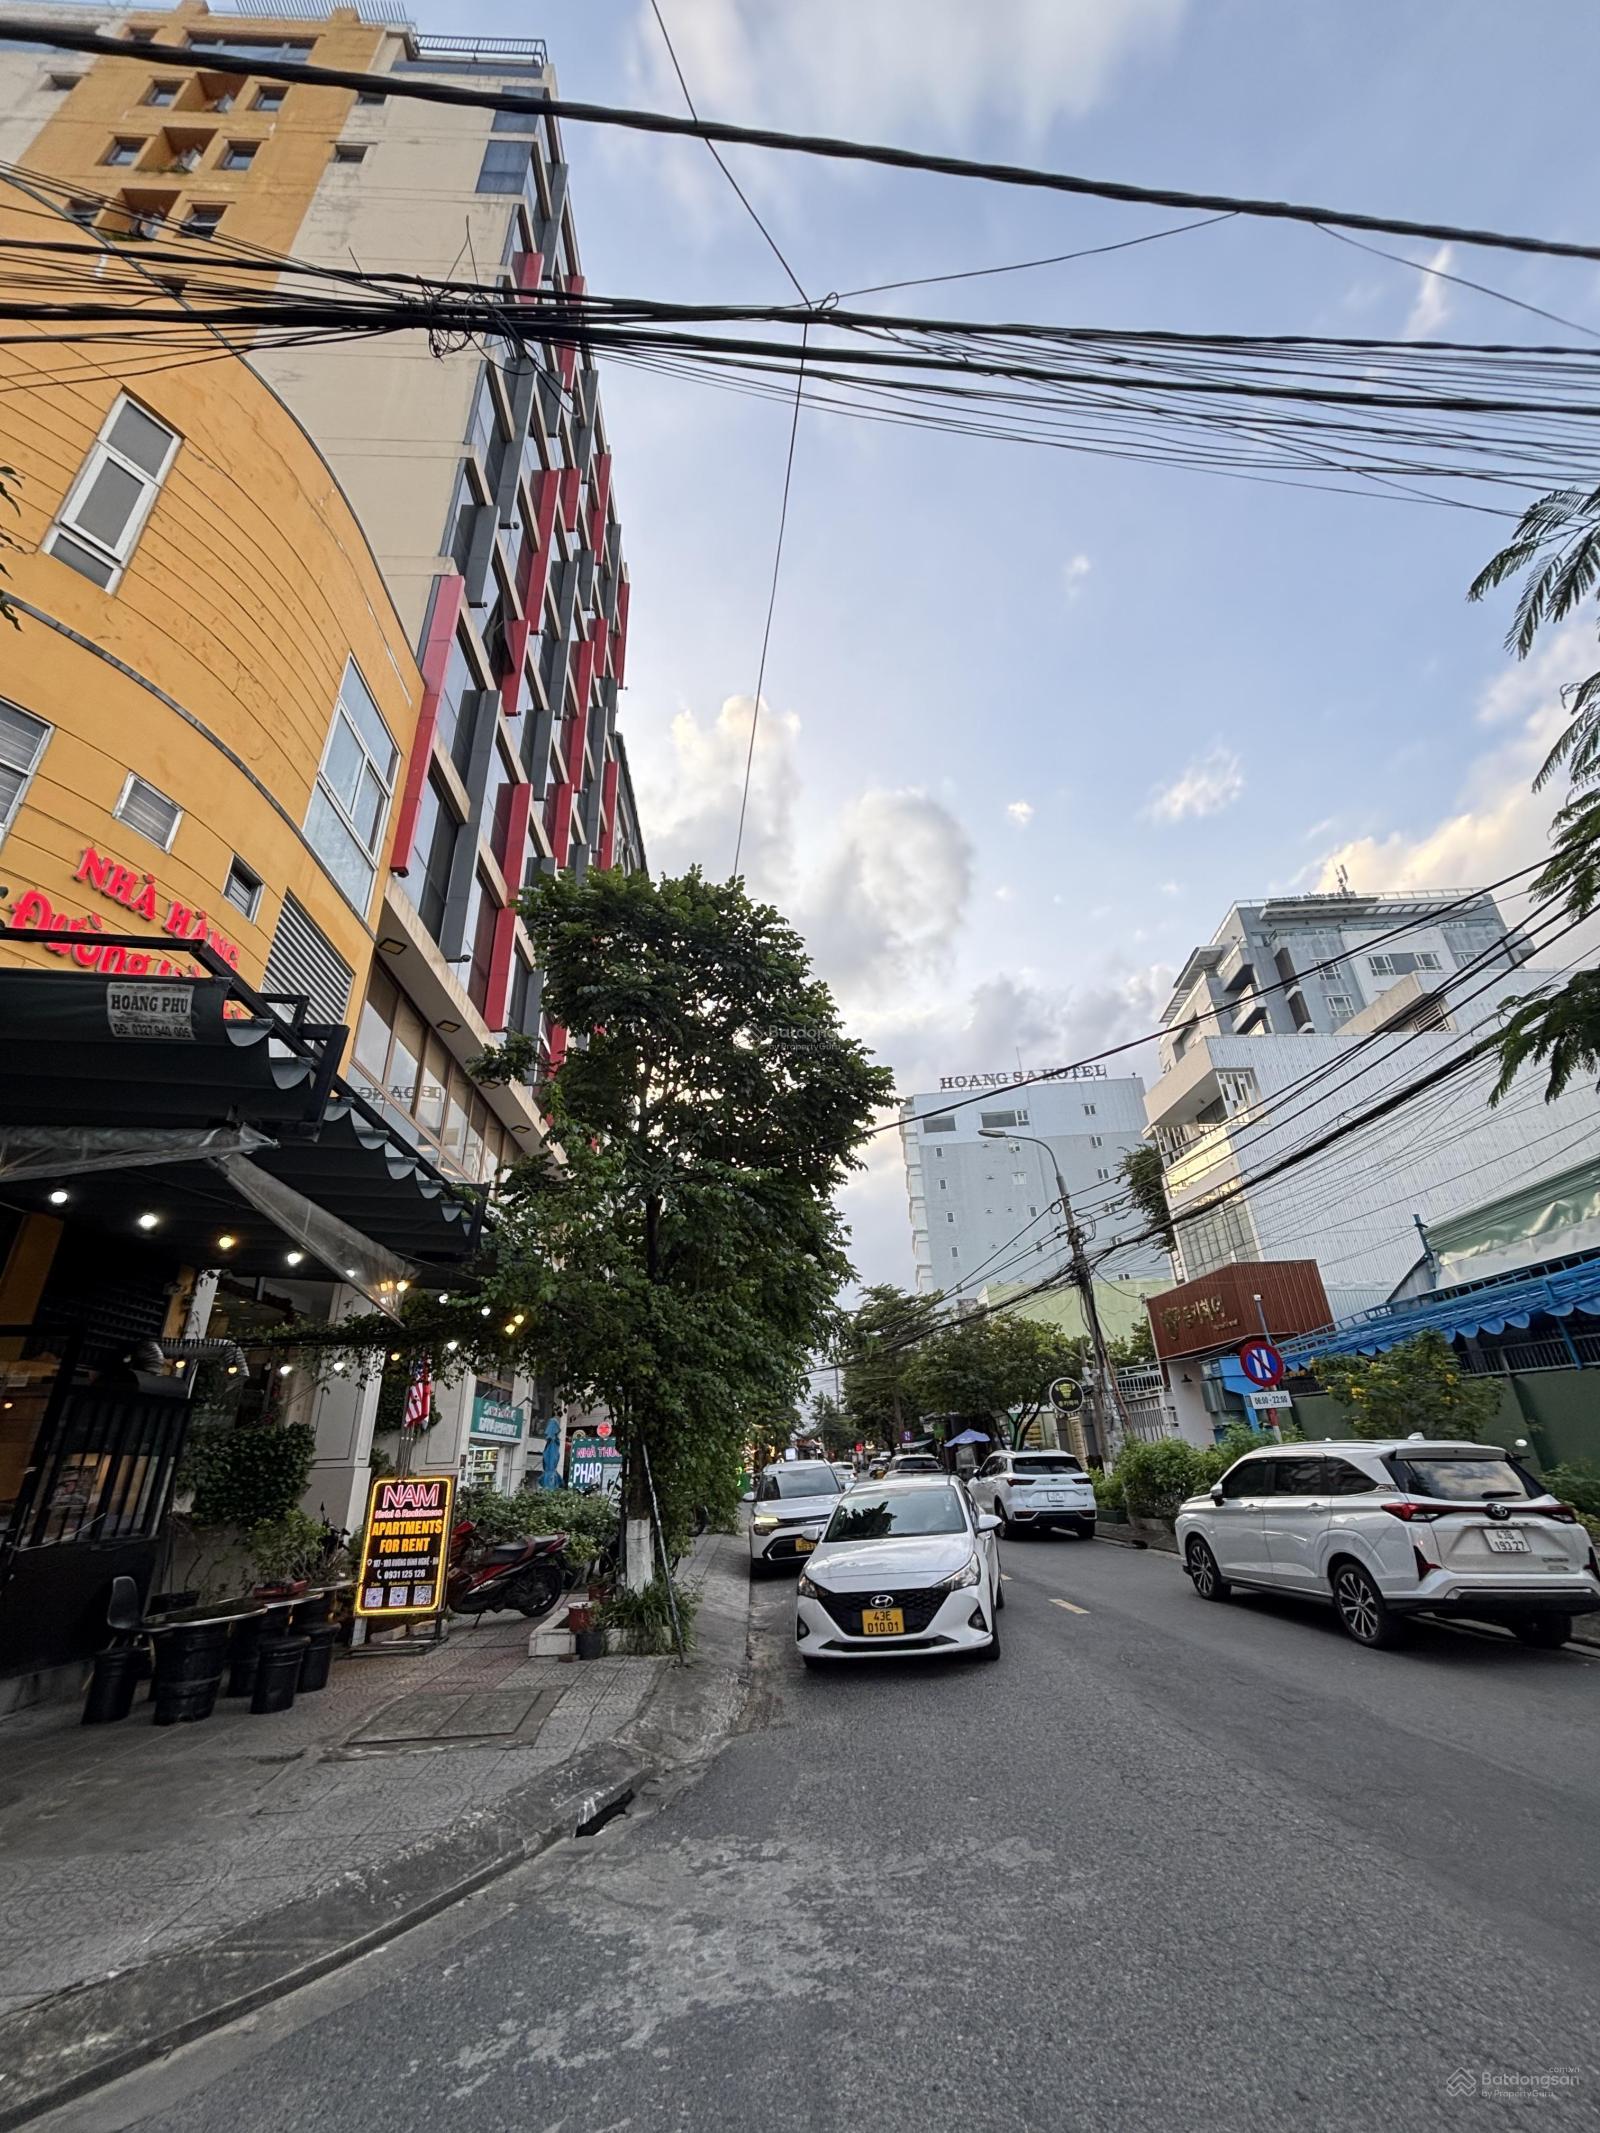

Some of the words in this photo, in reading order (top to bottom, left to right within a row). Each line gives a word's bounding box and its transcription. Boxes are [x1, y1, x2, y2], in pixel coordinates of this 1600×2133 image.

[74, 847, 158, 922] NHÀ
[940, 1072, 1008, 1089] HOANG
[1012, 1070, 1040, 1083] SA
[1041, 1064, 1107, 1081] HOTEL
[576, 1444, 597, 1458] NHÀ
[382, 1483, 440, 1508] NAM
[371, 1519, 443, 1536] APARTMENTS
[379, 1538, 400, 1553] FOR
[401, 1537, 431, 1553] RENT
[873, 1611, 892, 1621] 43E
[867, 1621, 899, 1633] 010.01
